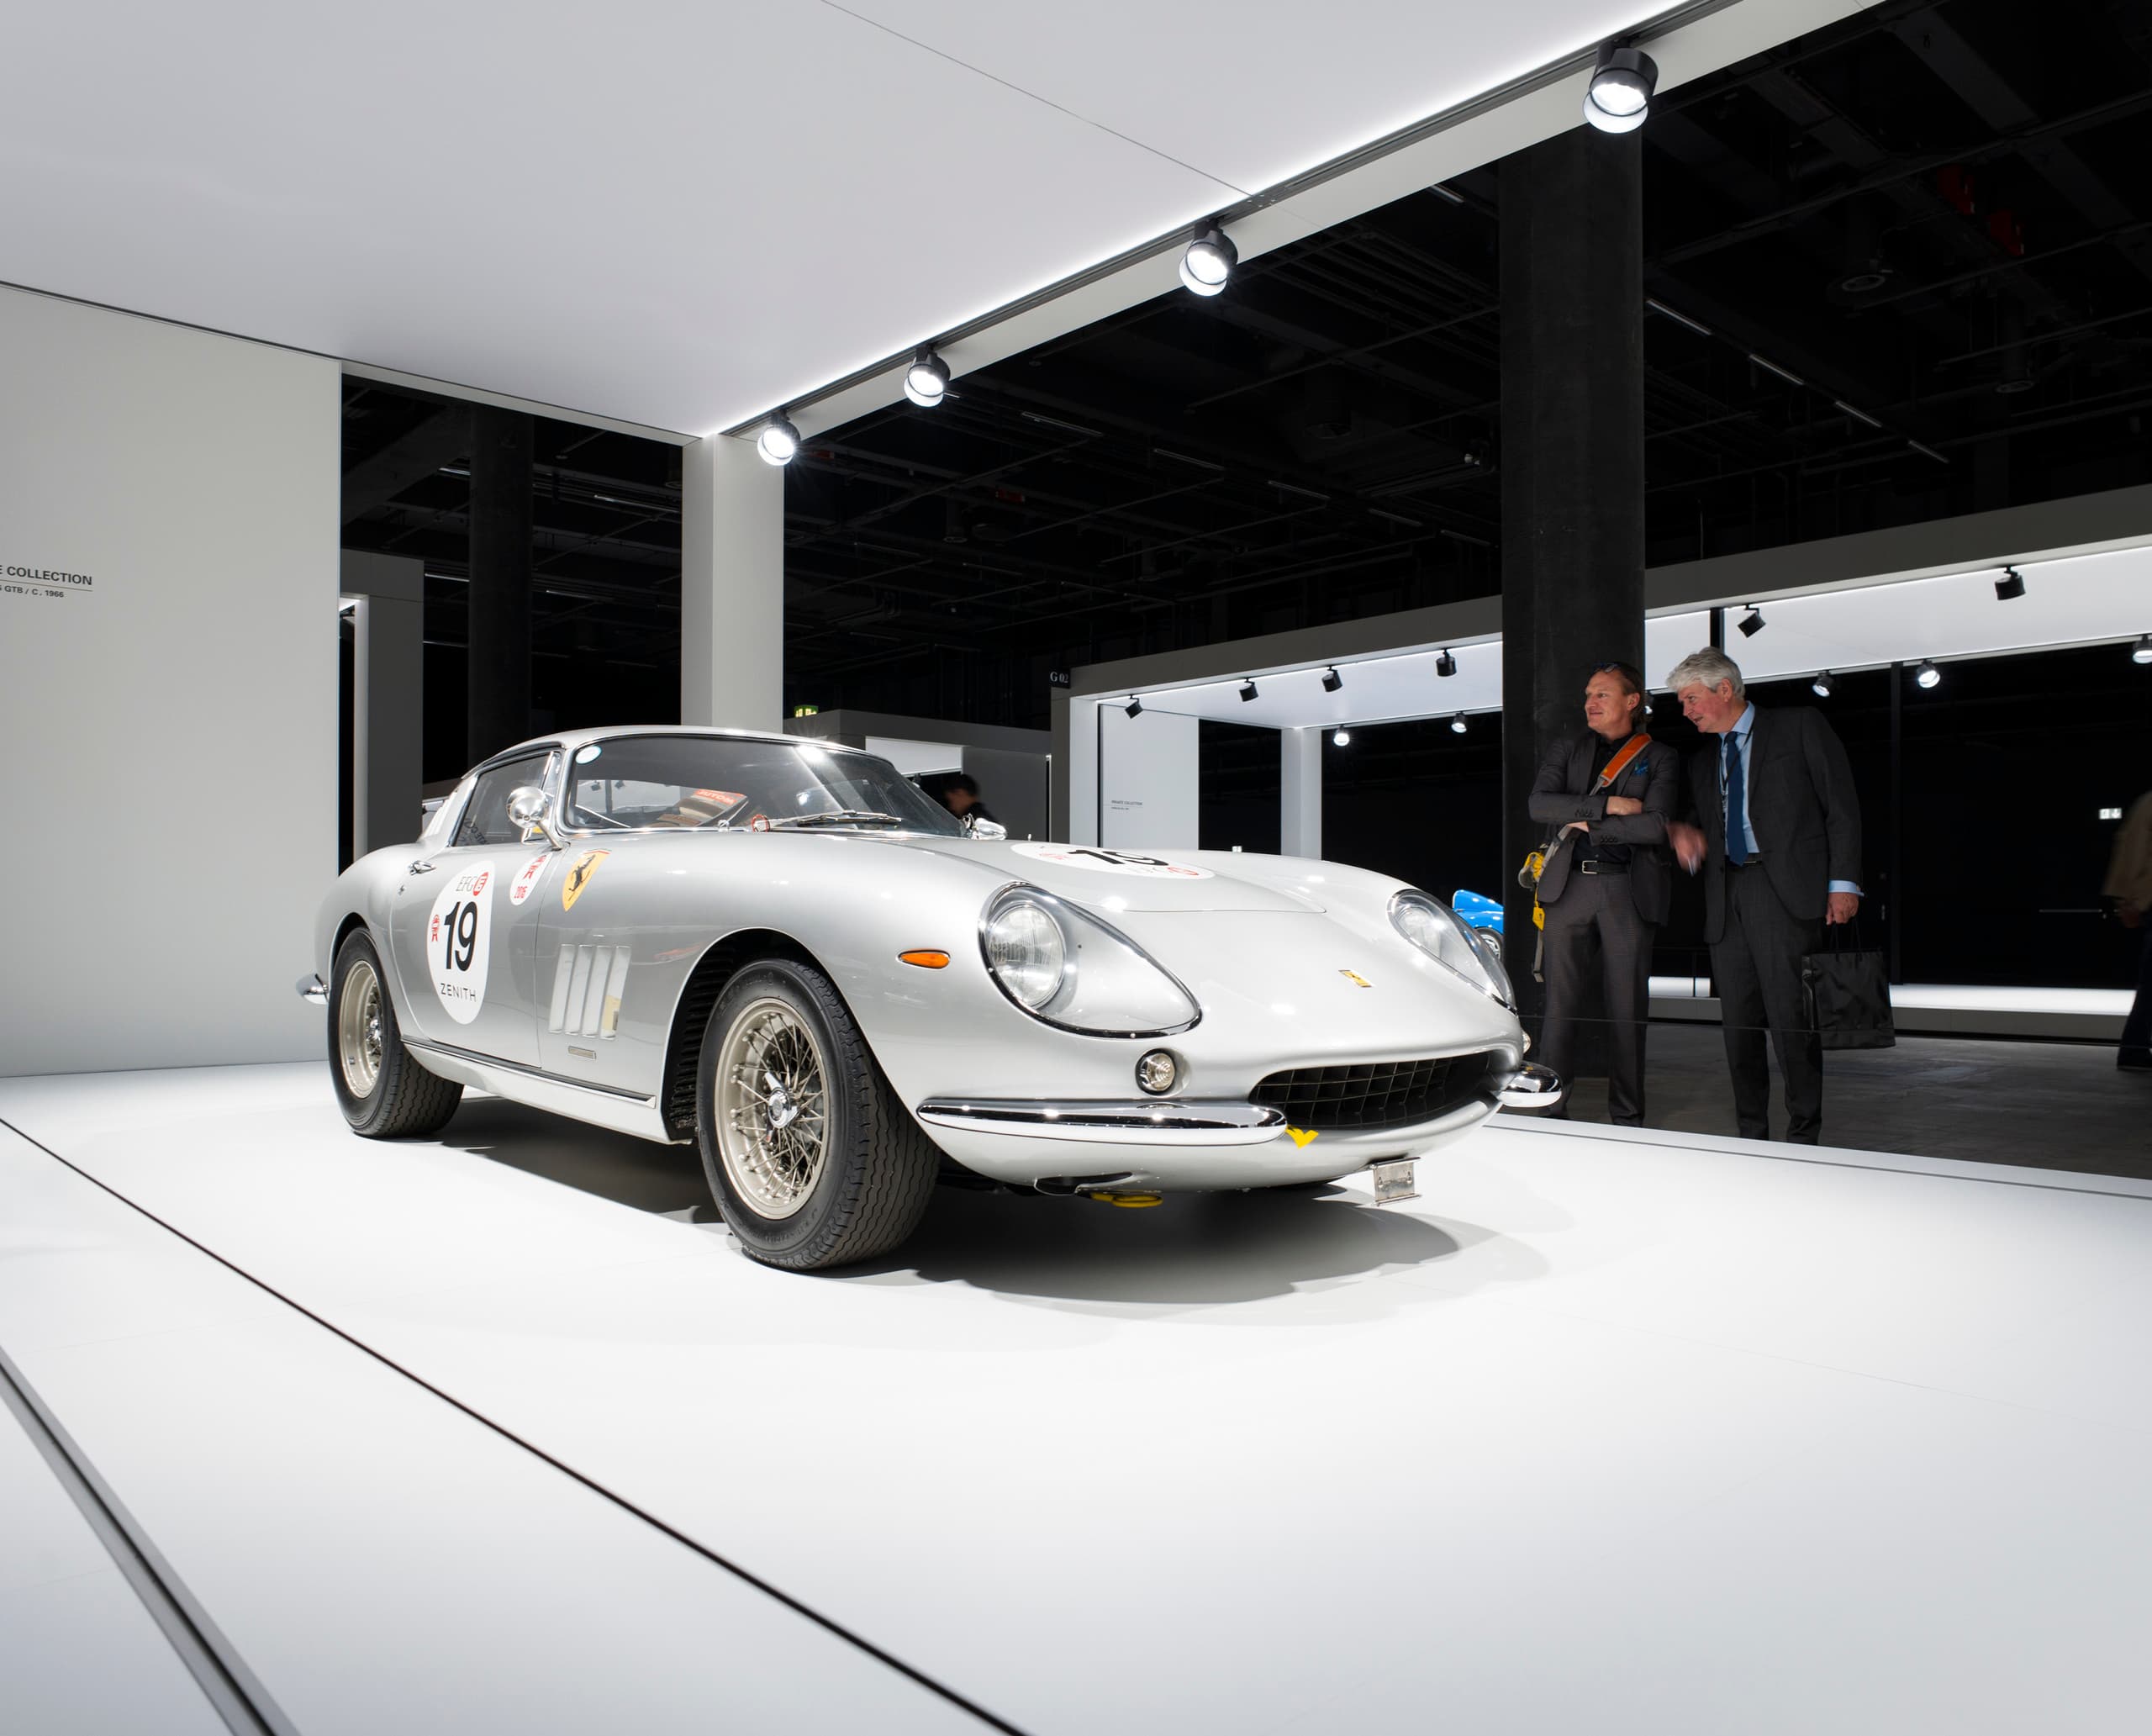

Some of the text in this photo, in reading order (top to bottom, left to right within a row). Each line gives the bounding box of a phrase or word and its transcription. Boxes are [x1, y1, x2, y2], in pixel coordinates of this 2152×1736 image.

[7, 566, 92, 585] COLLECTION
[4, 585, 24, 594] GTB
[45, 589, 65, 598] 1966
[1050, 671, 1068, 683] G 02
[444, 901, 478, 972] 19
[440, 983, 477, 1002] ZENITH
